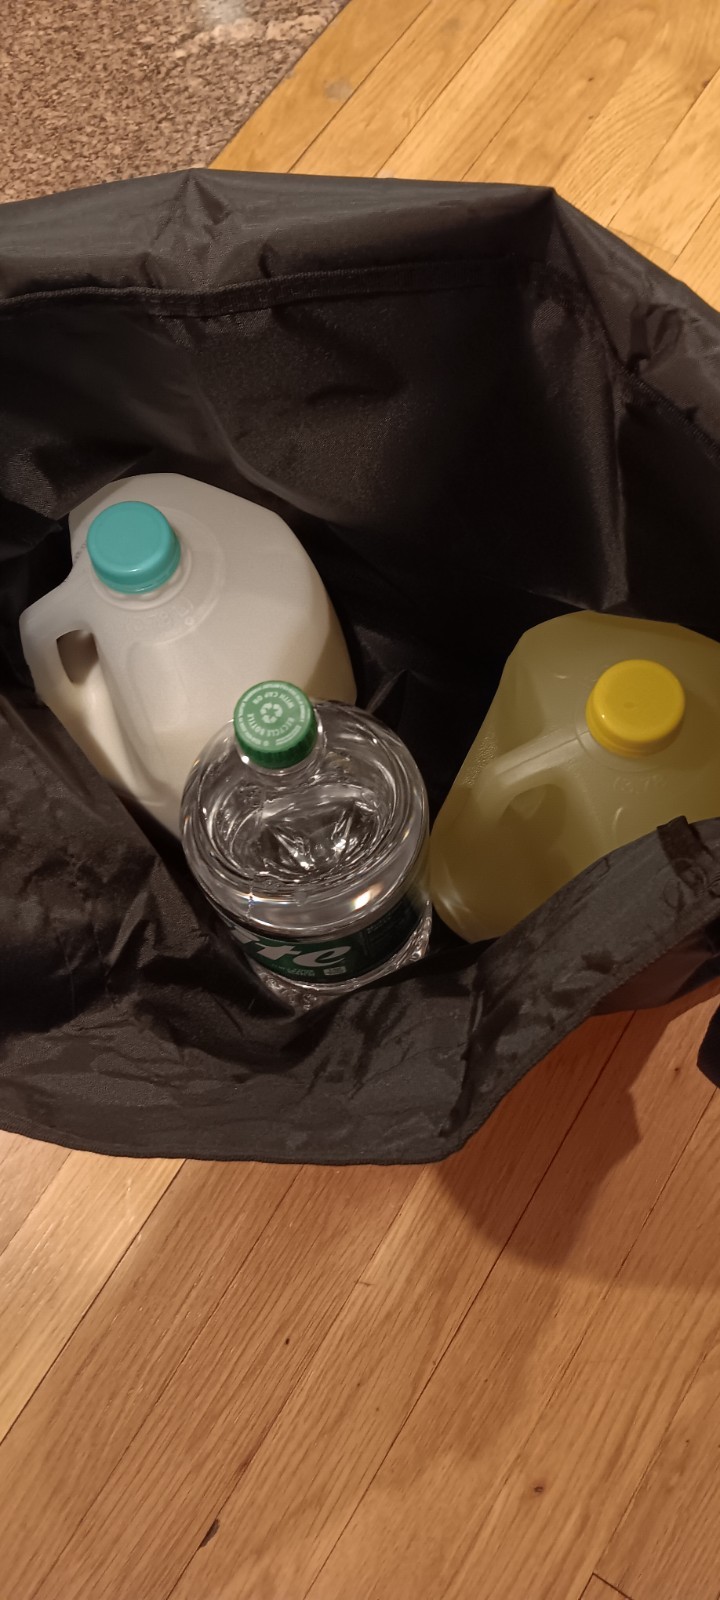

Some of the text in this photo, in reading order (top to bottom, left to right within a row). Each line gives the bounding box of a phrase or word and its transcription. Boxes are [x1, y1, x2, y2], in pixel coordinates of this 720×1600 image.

[279, 693, 295, 709] WITH
[246, 713, 265, 736] BOTTLE
[266, 717, 295, 738] RECYCLE
